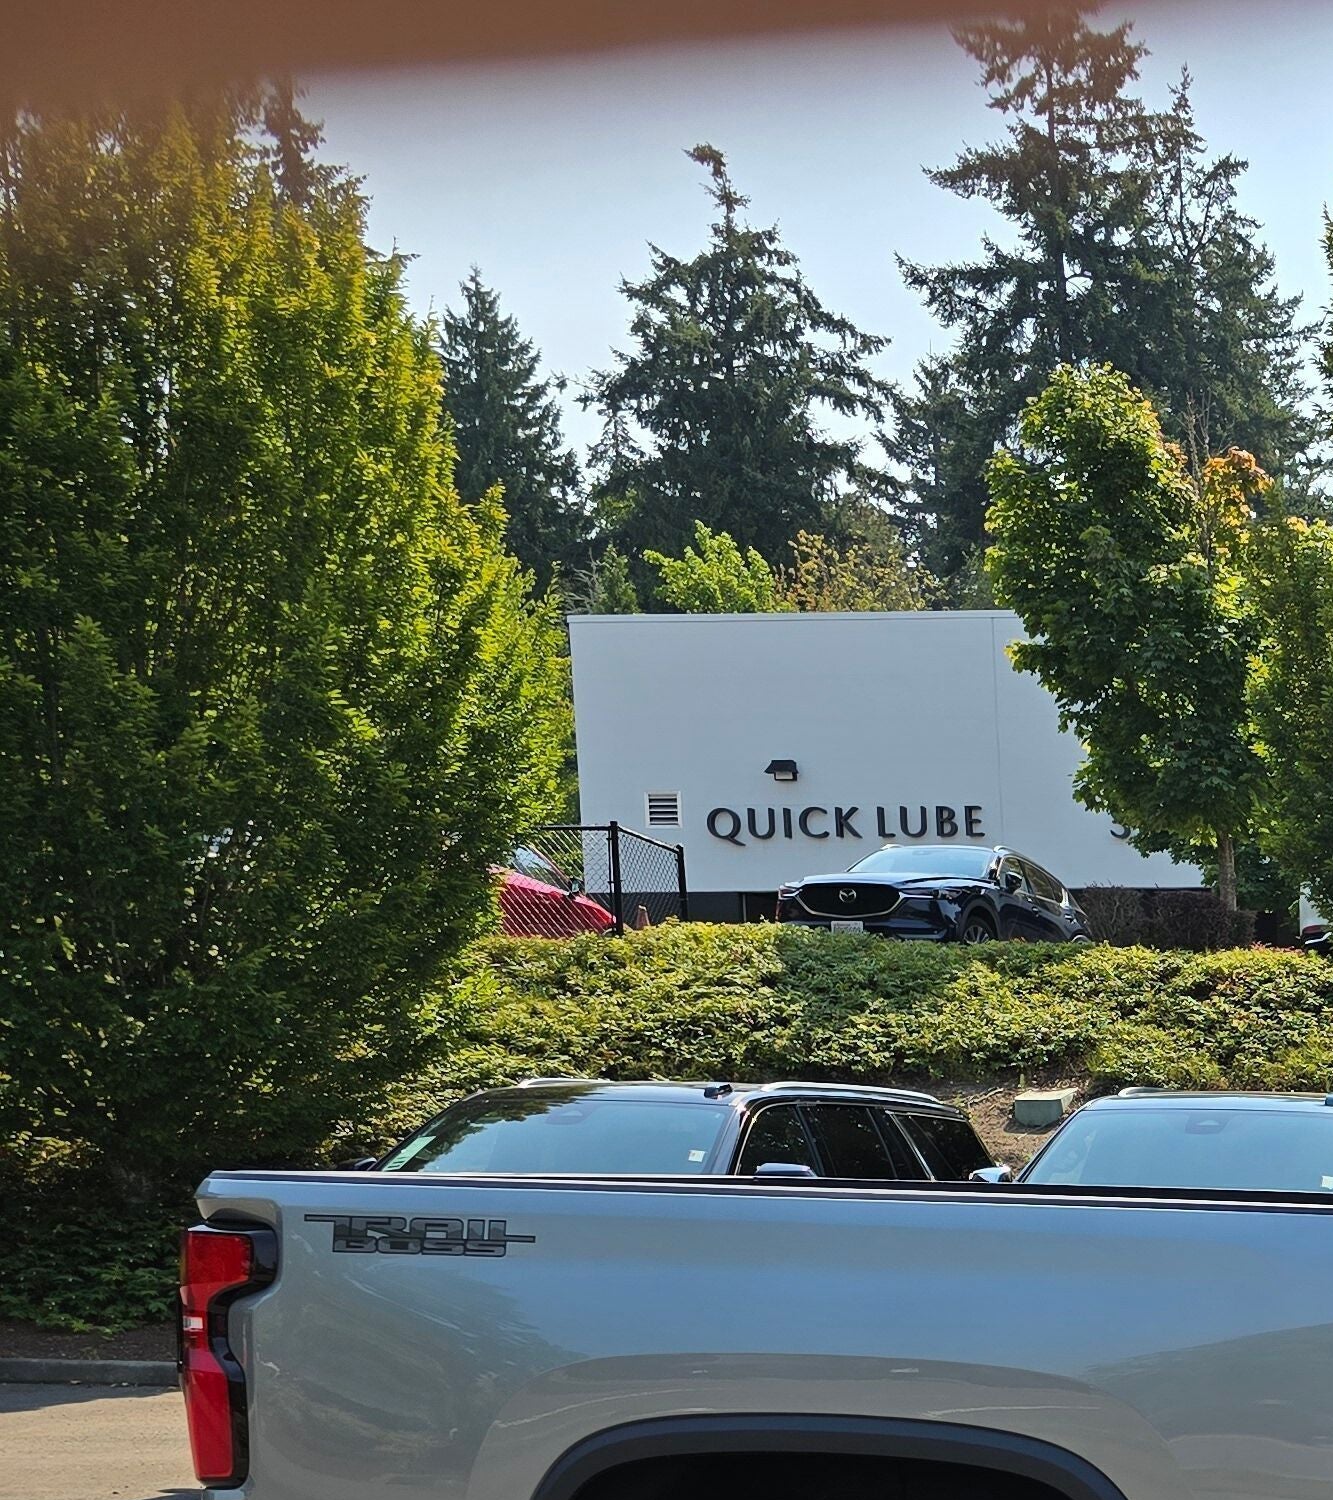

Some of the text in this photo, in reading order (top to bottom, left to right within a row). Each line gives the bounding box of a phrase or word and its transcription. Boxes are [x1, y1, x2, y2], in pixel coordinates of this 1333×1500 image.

[706, 805, 987, 847] QUICK LUBE
[304, 1213, 537, 1244] TRAIL
[332, 1236, 507, 1258] BOSS
